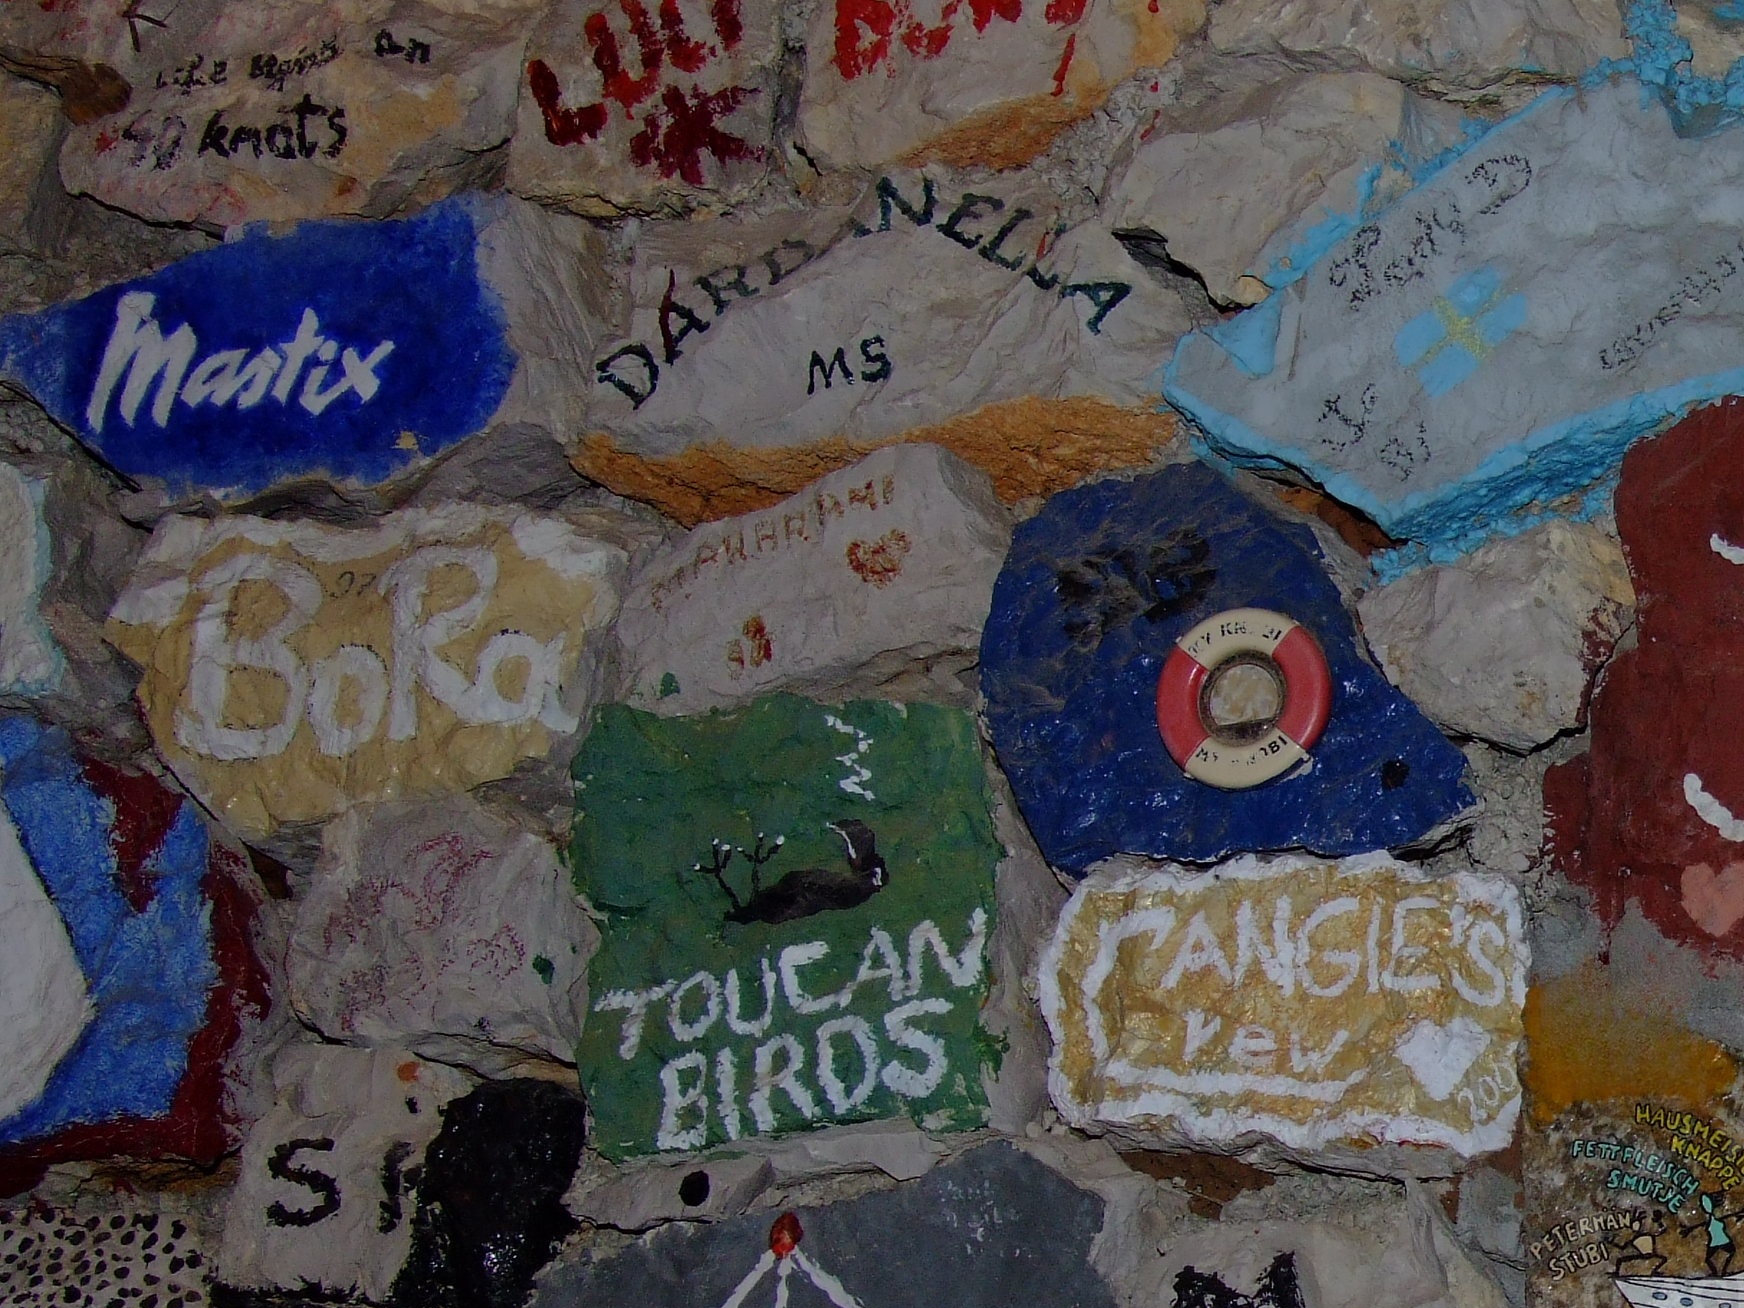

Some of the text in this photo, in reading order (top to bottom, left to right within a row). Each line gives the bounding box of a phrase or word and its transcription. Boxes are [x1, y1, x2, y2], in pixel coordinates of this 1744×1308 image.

[87, 290, 397, 432] Mastix
[593, 905, 988, 1061] TOUCAN
[656, 996, 955, 1152] BIRDS
[1571, 1138, 1701, 1197] FETTFLEISCH
[1606, 1167, 1687, 1216] SMUTJE
[1669, 1134, 1742, 1192] KNAPPE
[1547, 1242, 1610, 1282] STUBI
